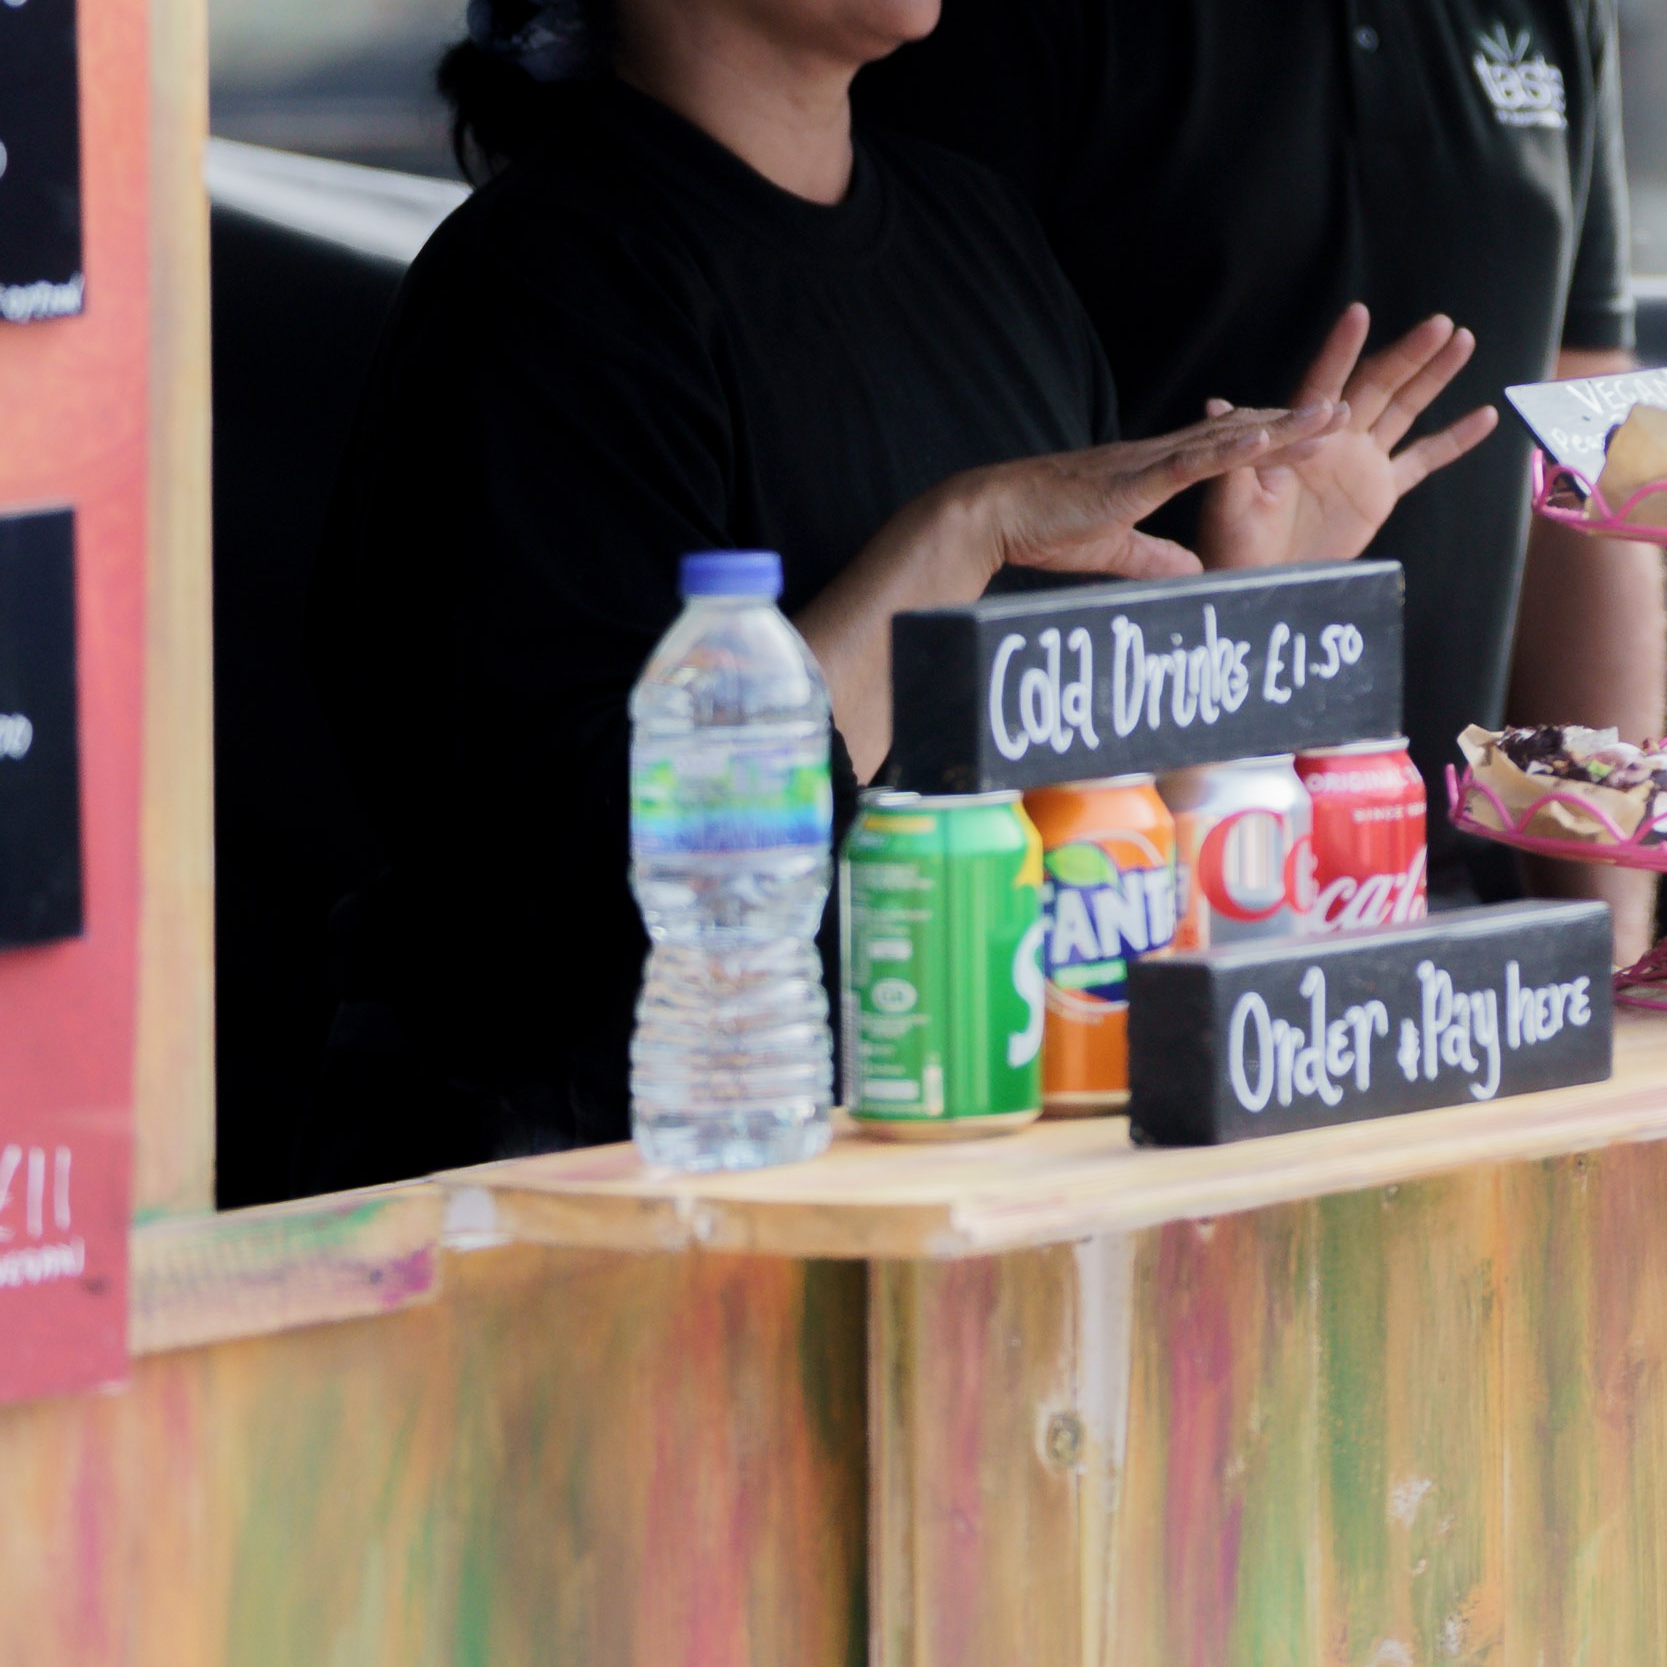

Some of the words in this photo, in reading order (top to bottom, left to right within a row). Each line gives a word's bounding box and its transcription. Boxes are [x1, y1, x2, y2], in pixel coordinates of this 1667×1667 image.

[990, 627, 1101, 761] Cold
[1111, 603, 1252, 737] Drinks
[1262, 622, 1364, 705] £1.50
[1228, 965, 1390, 1113] Order
[1417, 960, 1500, 1101] Pay
[1505, 960, 1592, 1051] here
